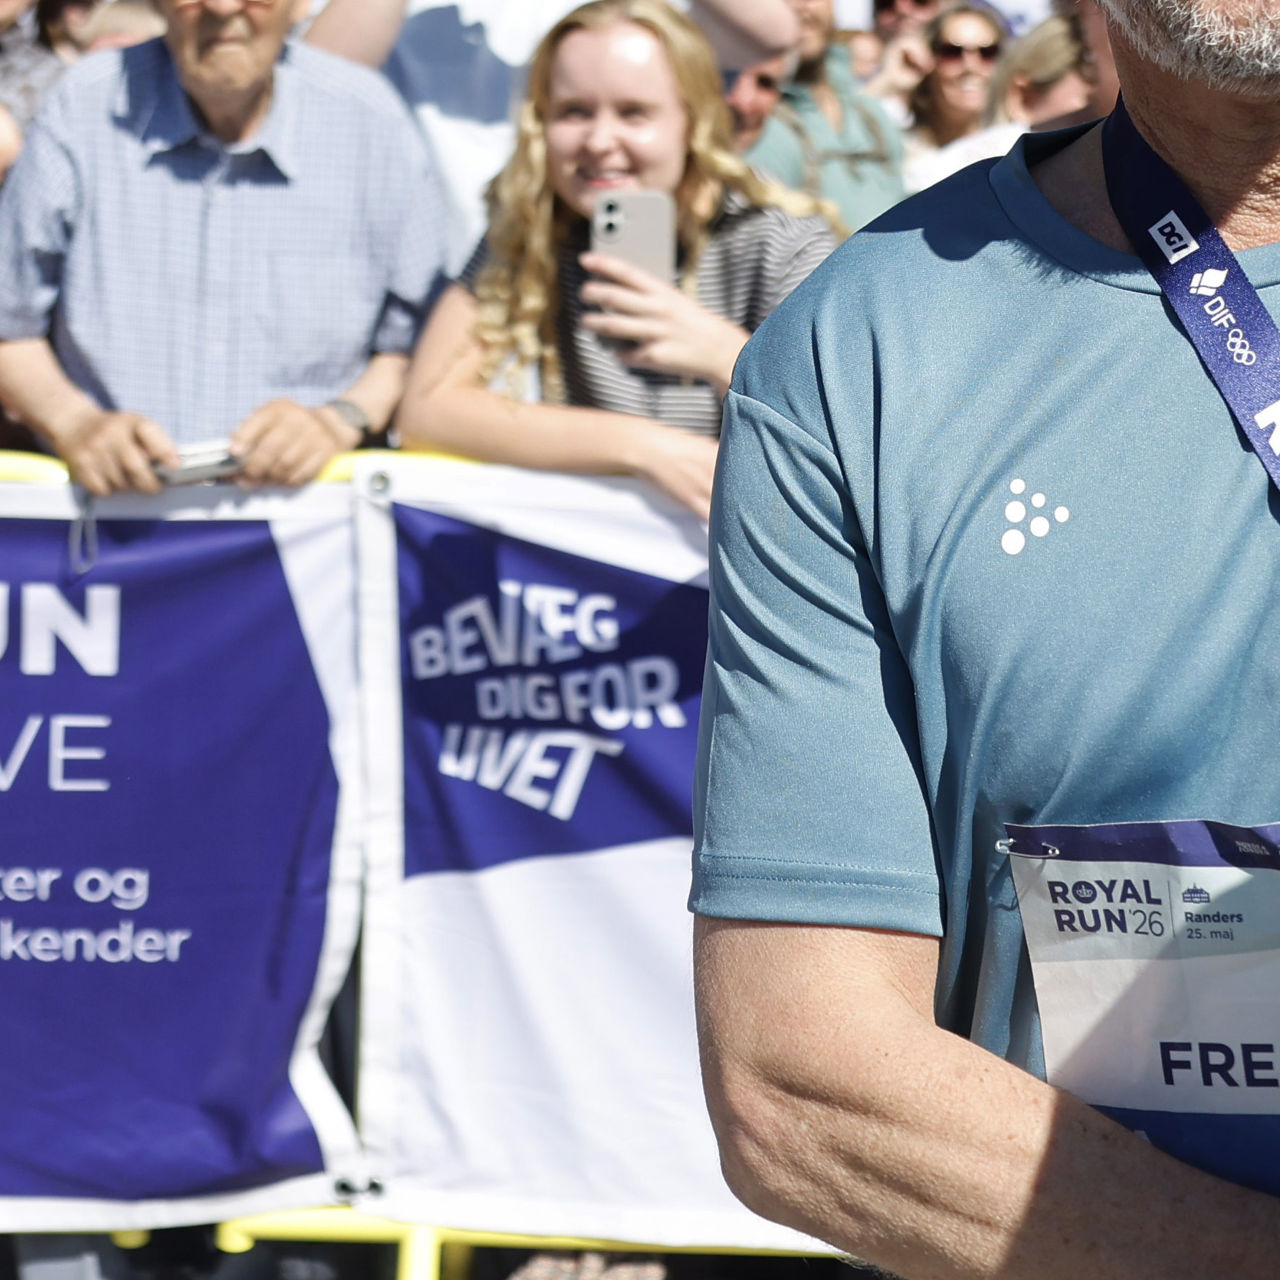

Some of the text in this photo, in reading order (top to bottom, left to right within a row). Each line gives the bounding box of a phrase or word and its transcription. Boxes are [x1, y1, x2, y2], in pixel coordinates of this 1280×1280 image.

[1157, 221, 1188, 254] DGI
[1203, 296, 1236, 328] DIF
[409, 579, 621, 680] BEVÆG
[476, 655, 688, 730] DIG FOR
[437, 724, 625, 822] LIVET
[73, 868, 150, 910] og
[1048, 880, 1162, 905] ROYAL
[1185, 911, 1244, 924] Randers
[1187, 928, 1234, 941] 25. maj
